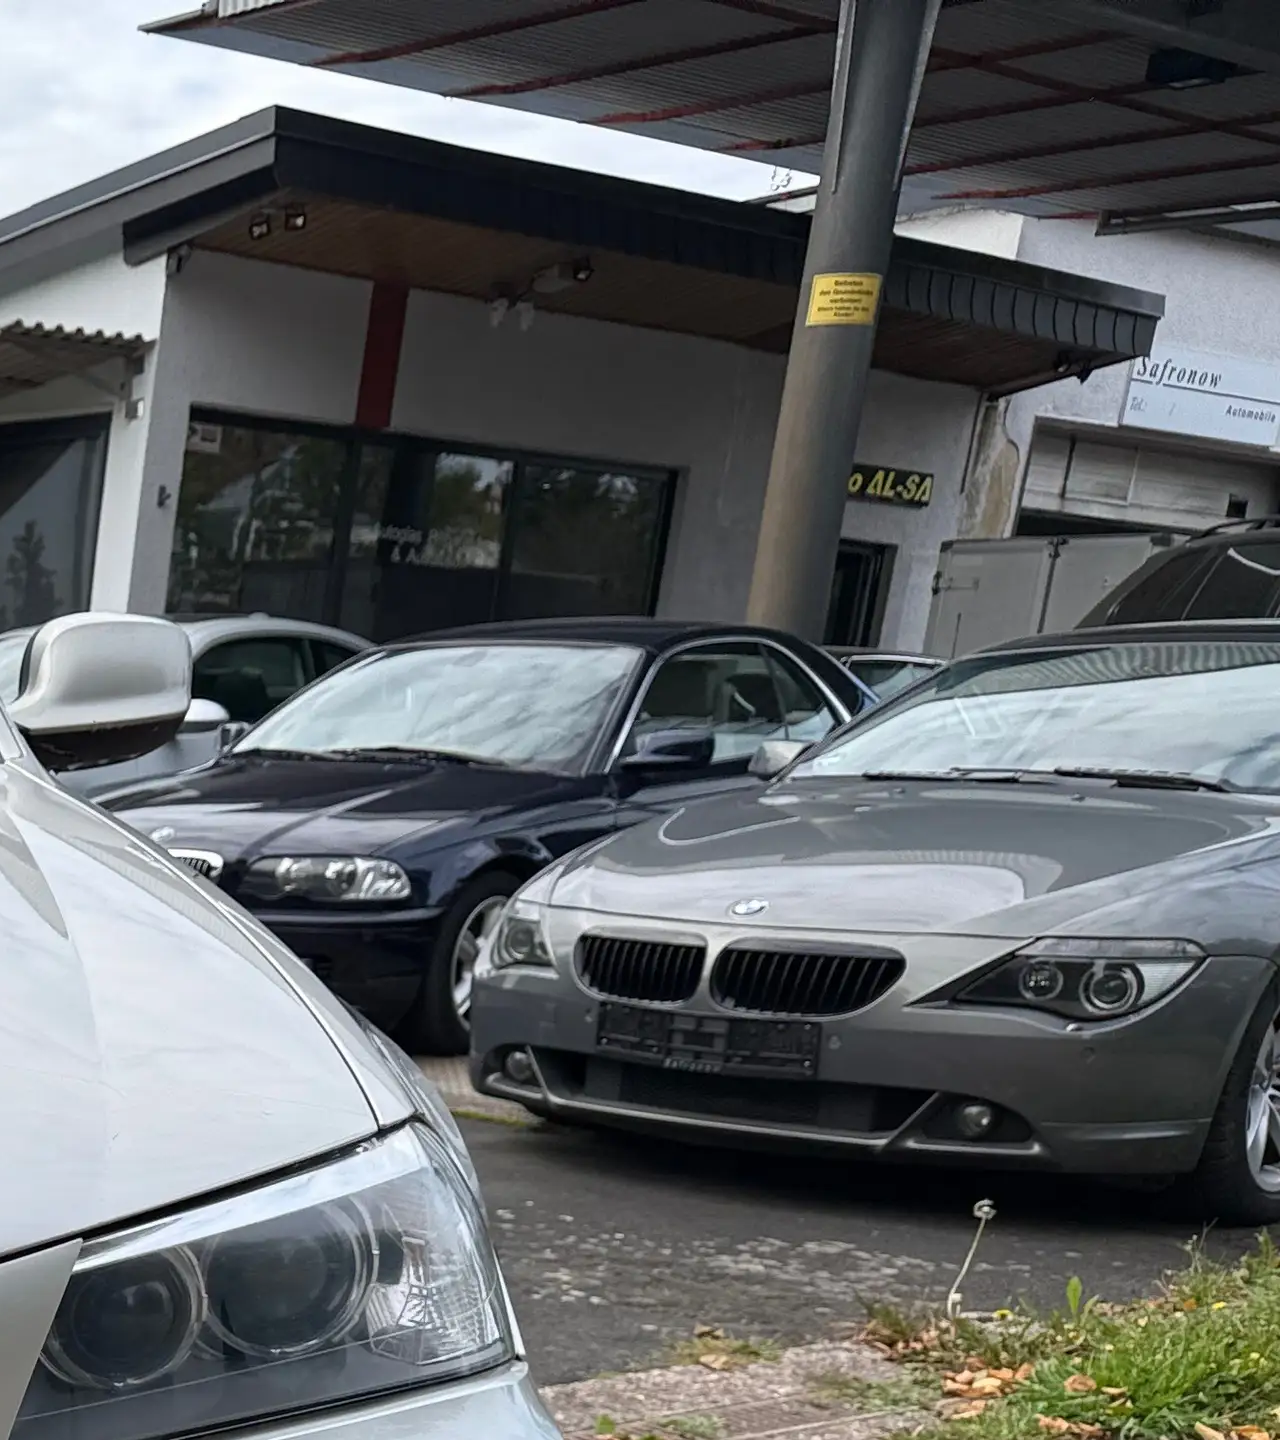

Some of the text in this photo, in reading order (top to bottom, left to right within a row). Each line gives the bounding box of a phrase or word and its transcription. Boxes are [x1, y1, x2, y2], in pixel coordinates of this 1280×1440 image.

[1137, 356, 1222, 388] Safronow
[1225, 404, 1277, 424] Automobile
[866, 469, 933, 503] AL-SA
